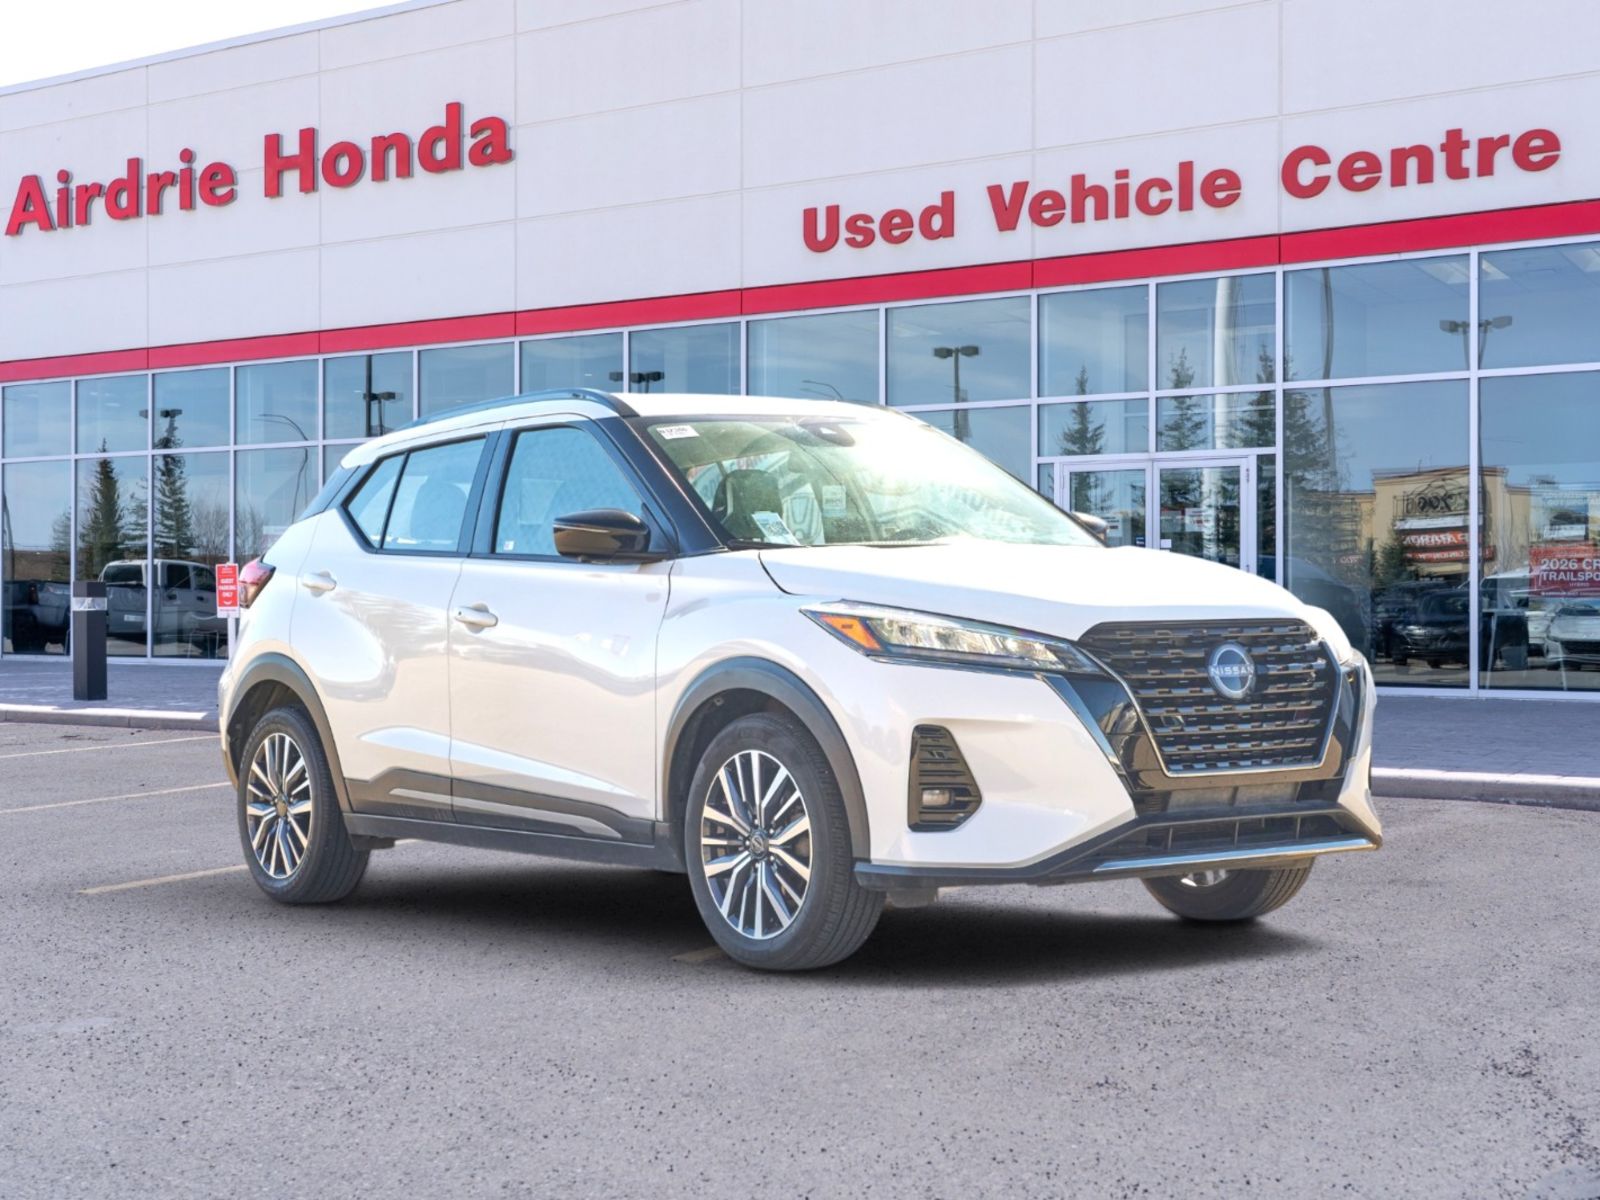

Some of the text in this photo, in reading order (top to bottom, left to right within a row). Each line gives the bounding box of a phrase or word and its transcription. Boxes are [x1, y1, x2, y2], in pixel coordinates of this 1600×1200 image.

[6, 102, 513, 236] Airdrie Honda
[803, 128, 1561, 252] Used Vehicle Centre
[1541, 559, 1577, 570] 2026
[1210, 665, 1254, 676] NISSAN
